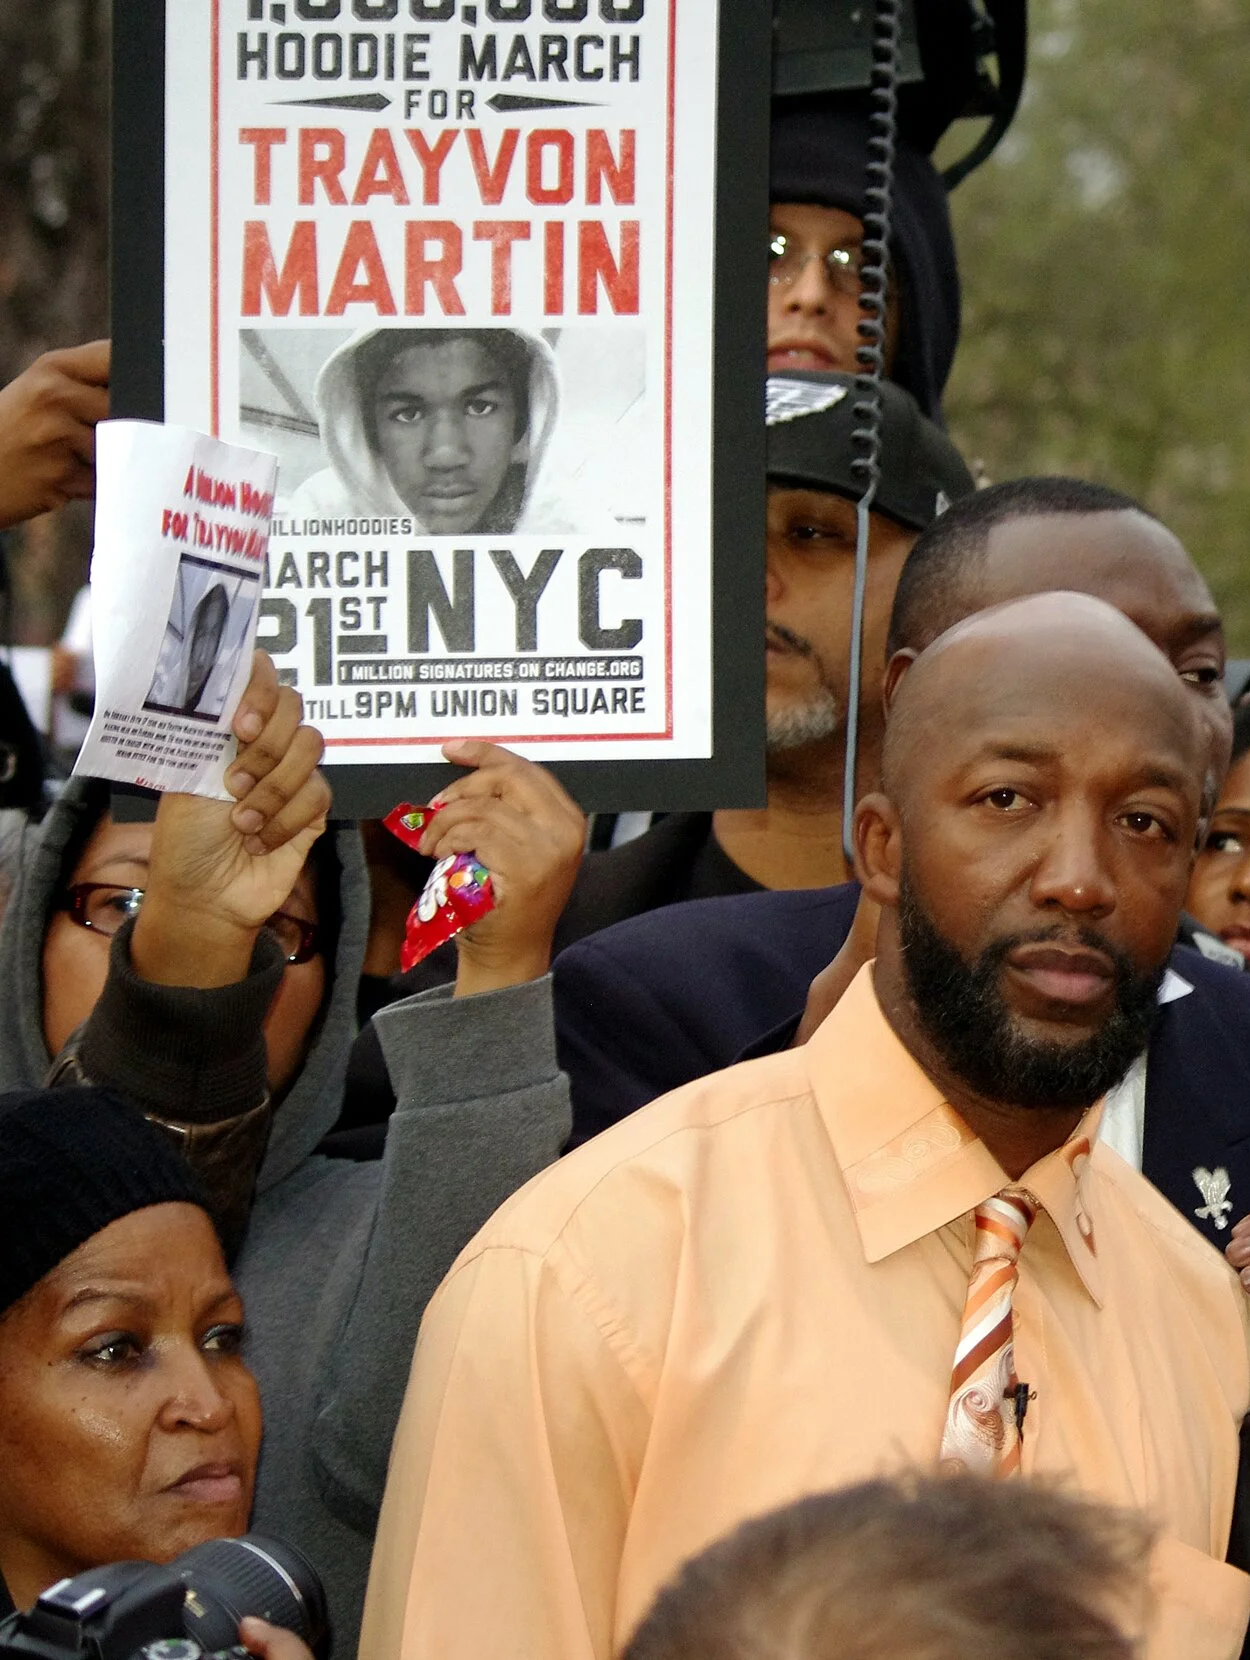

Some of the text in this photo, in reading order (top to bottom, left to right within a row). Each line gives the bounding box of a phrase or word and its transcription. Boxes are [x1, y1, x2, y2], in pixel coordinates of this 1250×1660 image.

[236, 32, 641, 82] HOODIE MARCH
[403, 89, 476, 120] FOR
[238, 127, 636, 206] TRAYVON
[240, 220, 640, 316] MARTIN
[268, 518, 413, 537] ILLIONHOODIES
[406, 547, 643, 654] NYC
[352, 664, 413, 681] MILLION
[419, 663, 513, 679] SIGNATURES
[519, 663, 540, 678] ON
[545, 661, 641, 678] CHANGE.ORG
[430, 689, 519, 718] UNION
[532, 687, 646, 718] SQUARE
